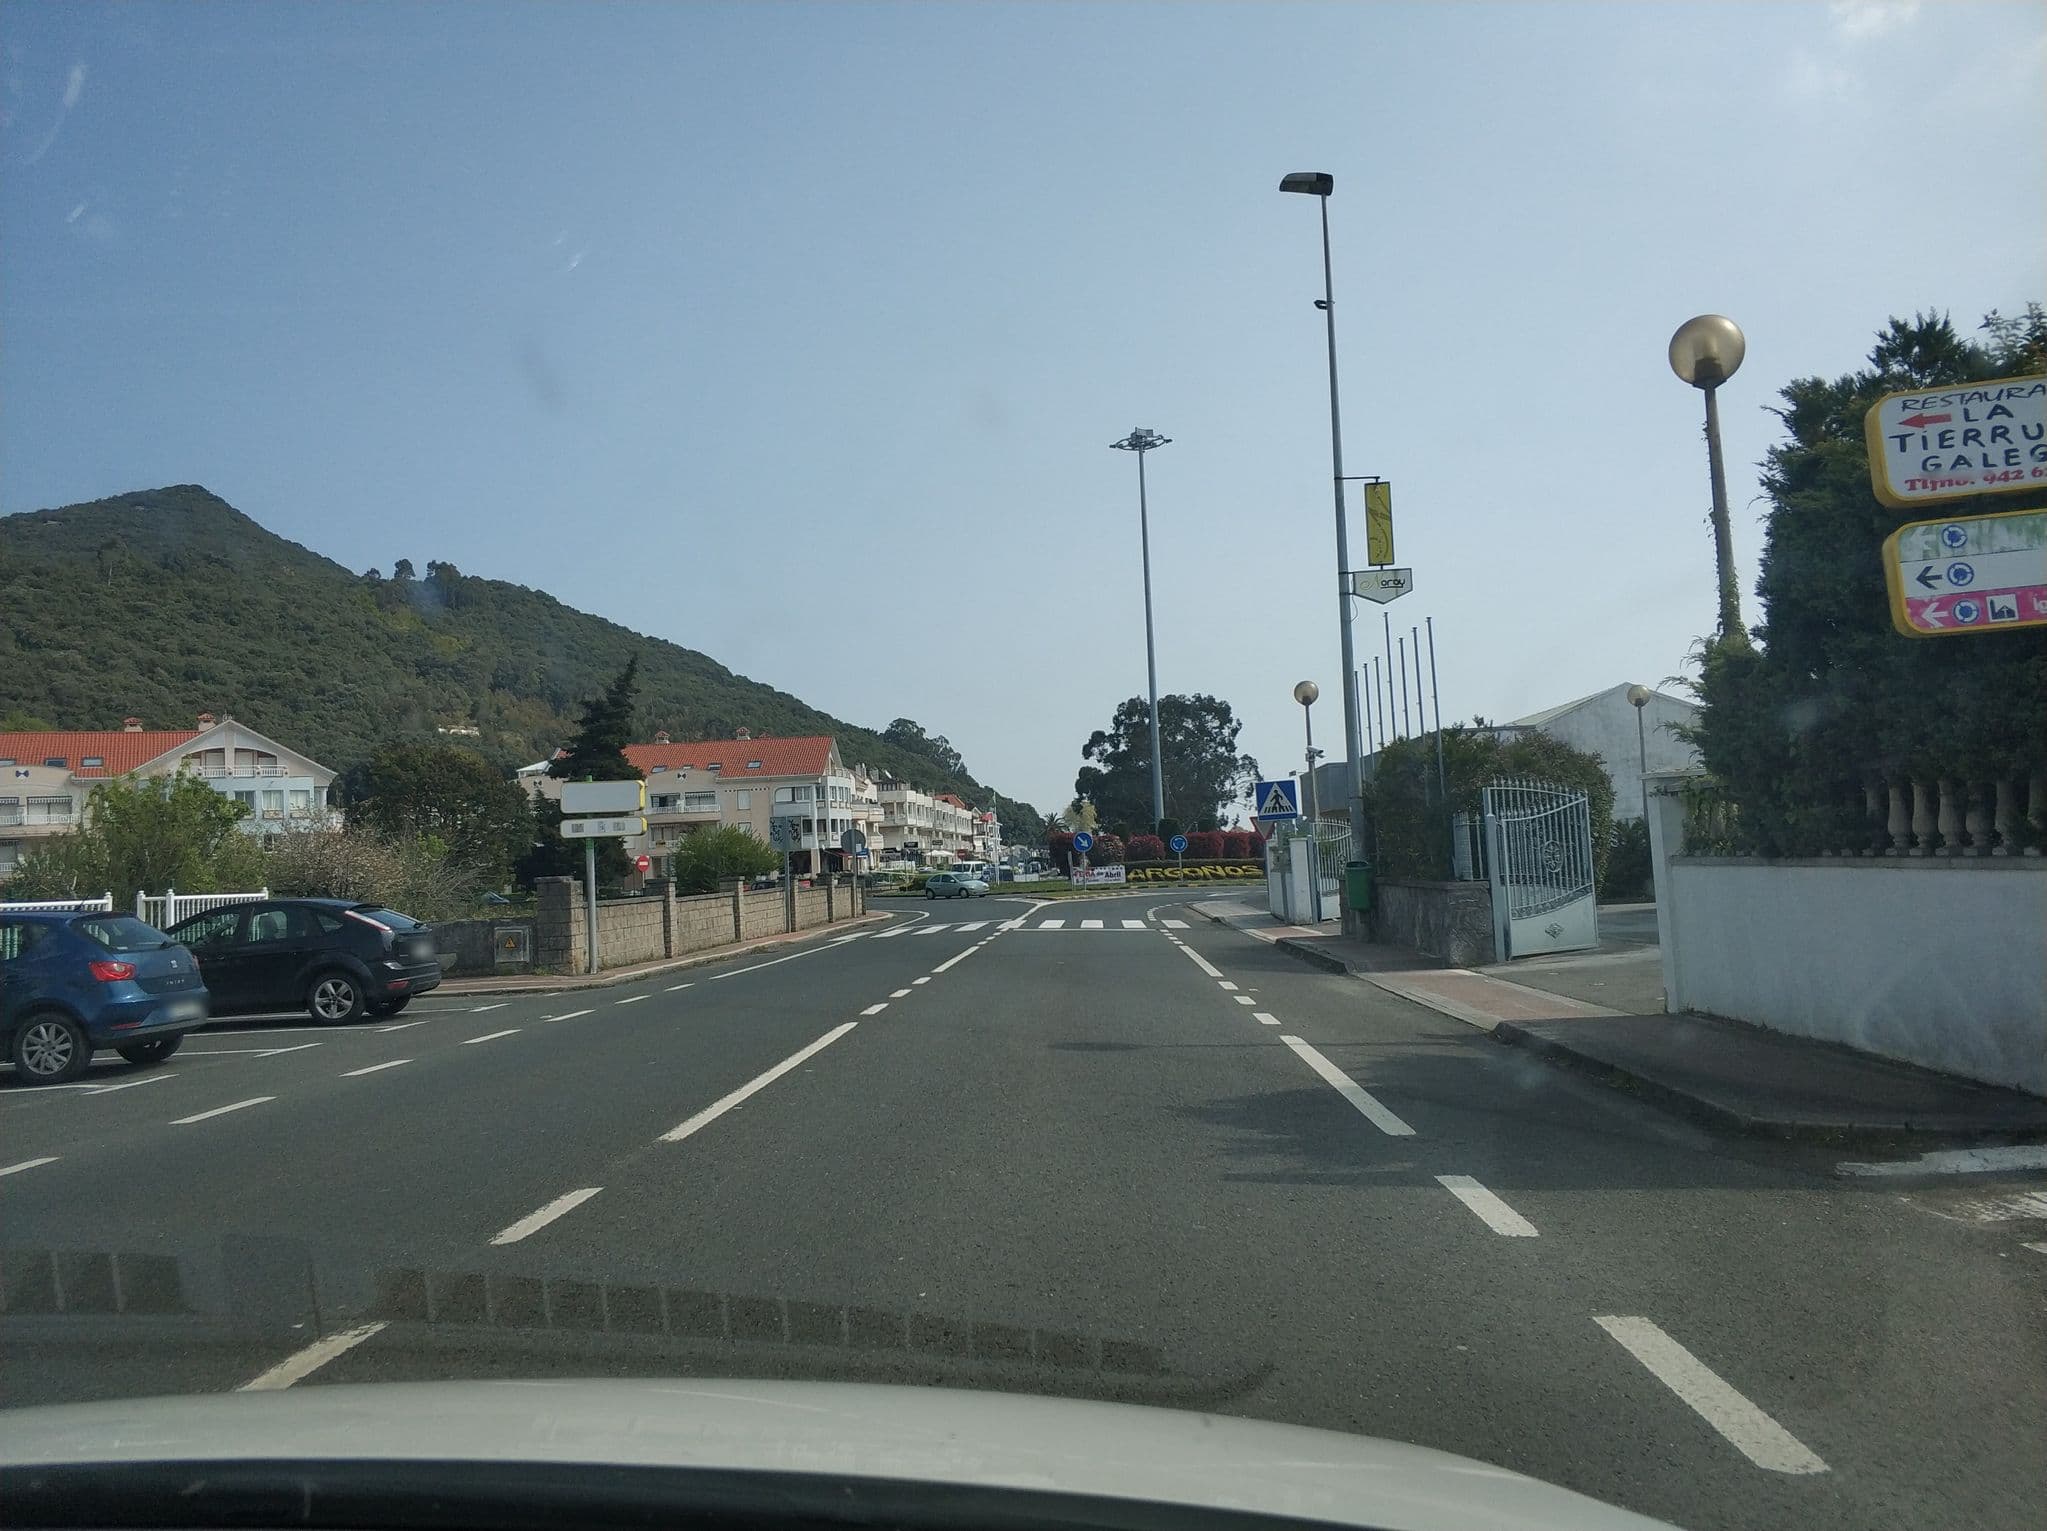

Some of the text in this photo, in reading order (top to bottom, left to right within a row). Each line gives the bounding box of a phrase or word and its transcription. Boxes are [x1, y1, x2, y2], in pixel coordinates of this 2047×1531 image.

[1902, 384, 2047, 412] RESTAURA
[1963, 404, 2014, 422] LA
[1983, 469, 2025, 484] 942
[2031, 466, 2047, 478] 6
